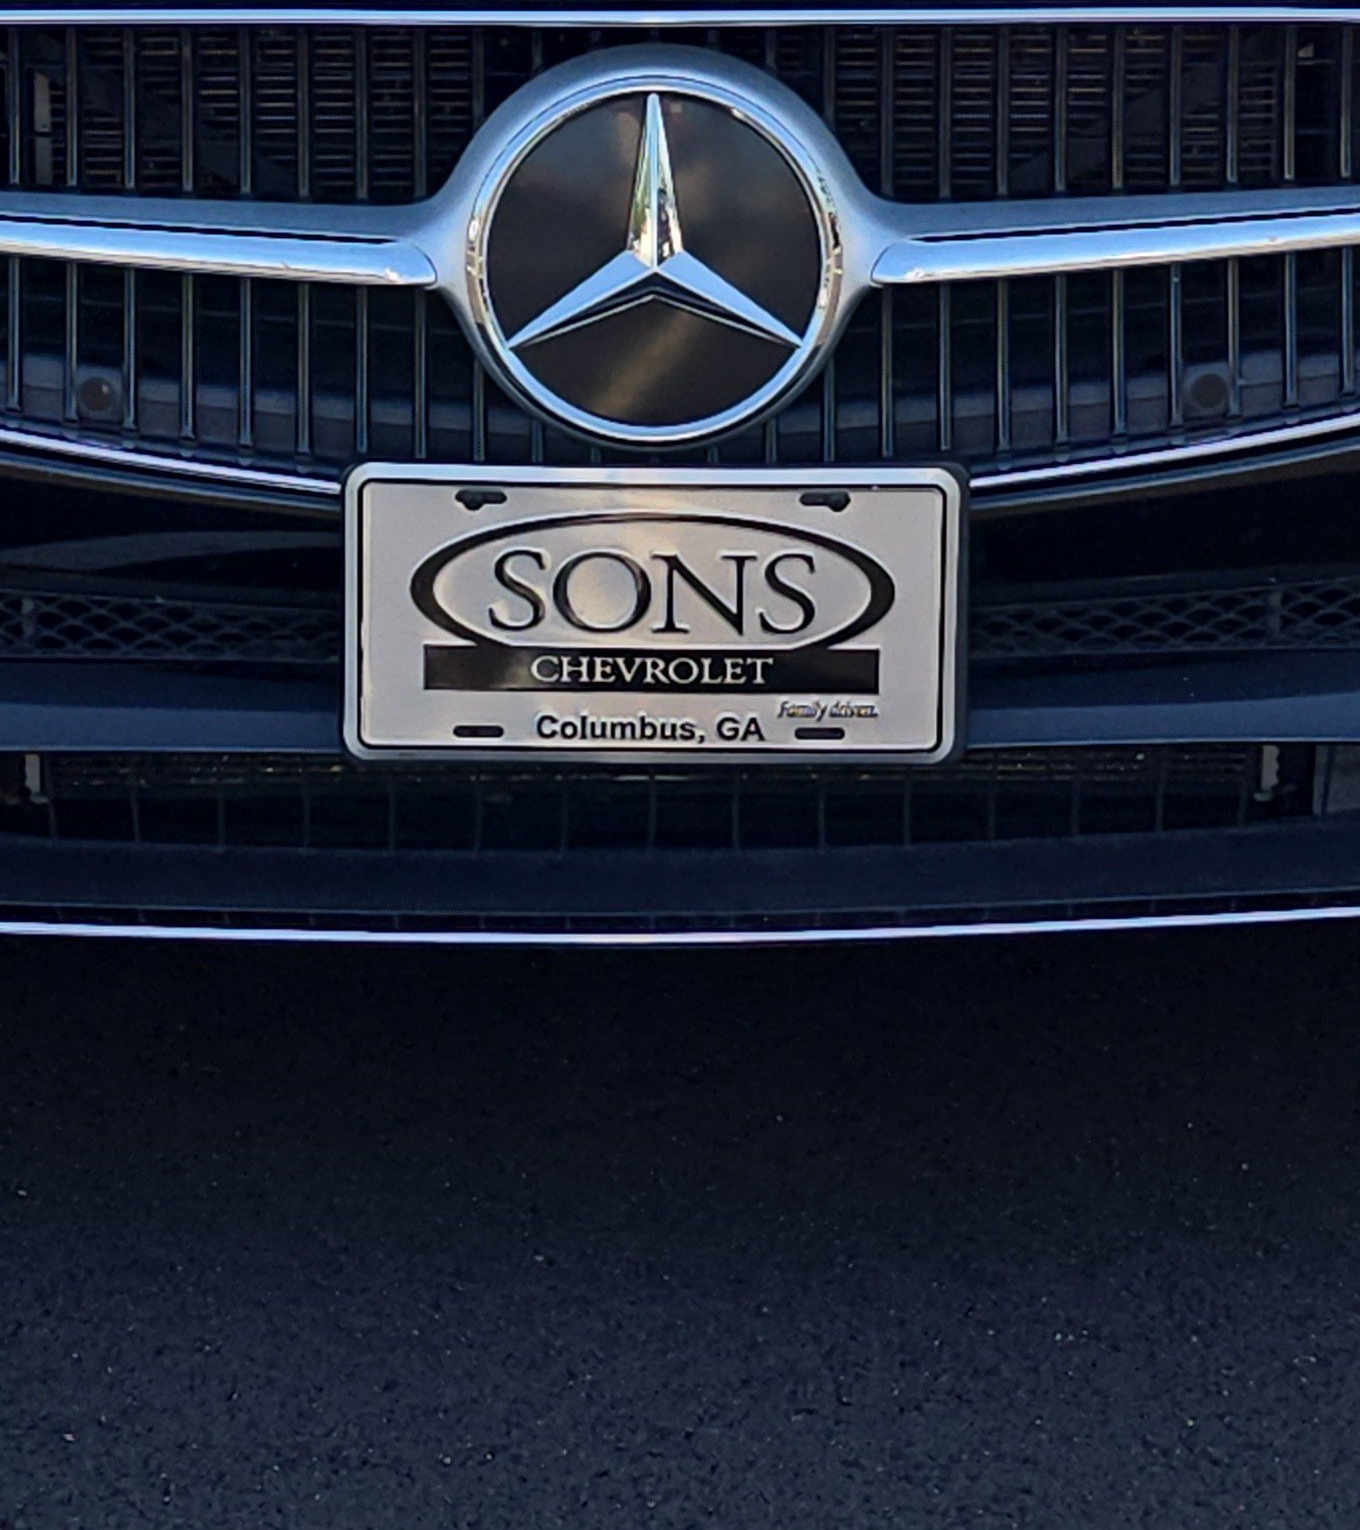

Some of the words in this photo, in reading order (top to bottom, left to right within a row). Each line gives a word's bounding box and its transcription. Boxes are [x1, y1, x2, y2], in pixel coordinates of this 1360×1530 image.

[489, 550, 816, 635] SONS
[531, 656, 774, 685] CHEVROLET
[536, 713, 706, 743] Columbus,
[717, 716, 766, 741] GA
